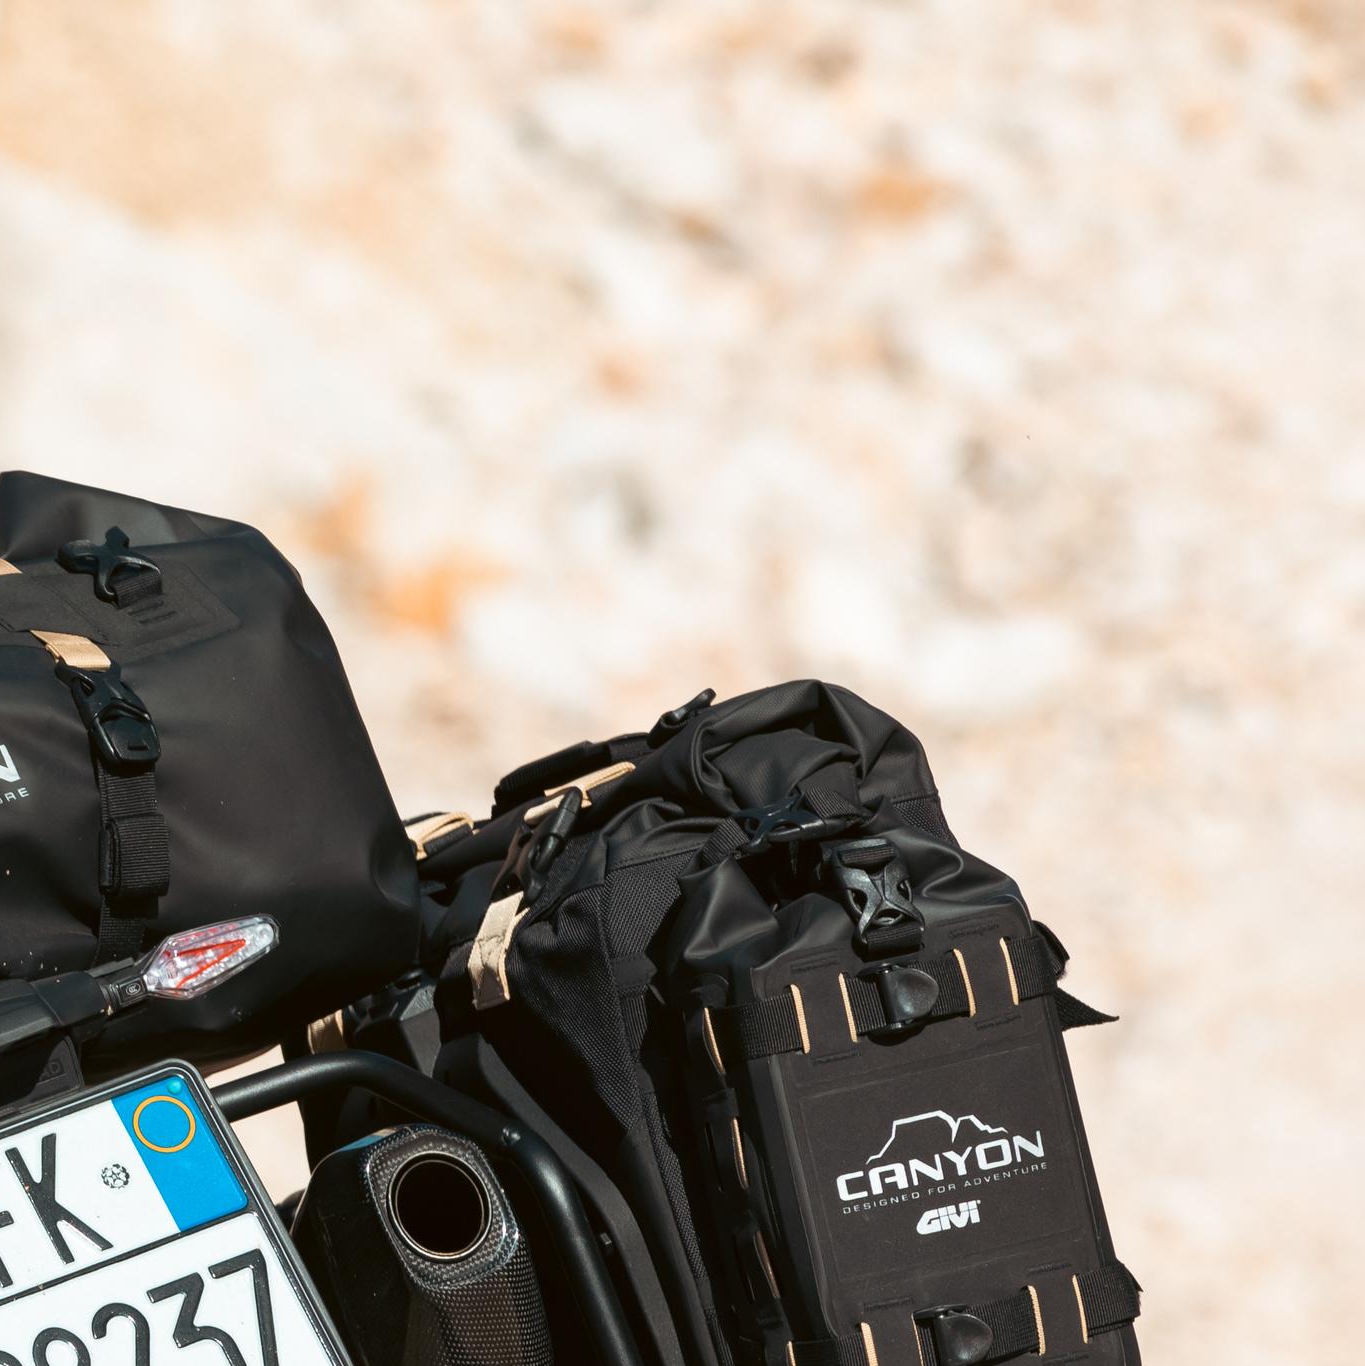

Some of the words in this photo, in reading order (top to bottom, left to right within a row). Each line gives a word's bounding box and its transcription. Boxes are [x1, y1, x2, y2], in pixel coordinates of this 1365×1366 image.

[836, 1130, 1045, 1202] CANYON
[842, 1191, 920, 1215] DESIGNED
[927, 1183, 957, 1197] FOR
[963, 1161, 1048, 1189] ADVENTURE
[916, 1200, 982, 1236] GIVI
